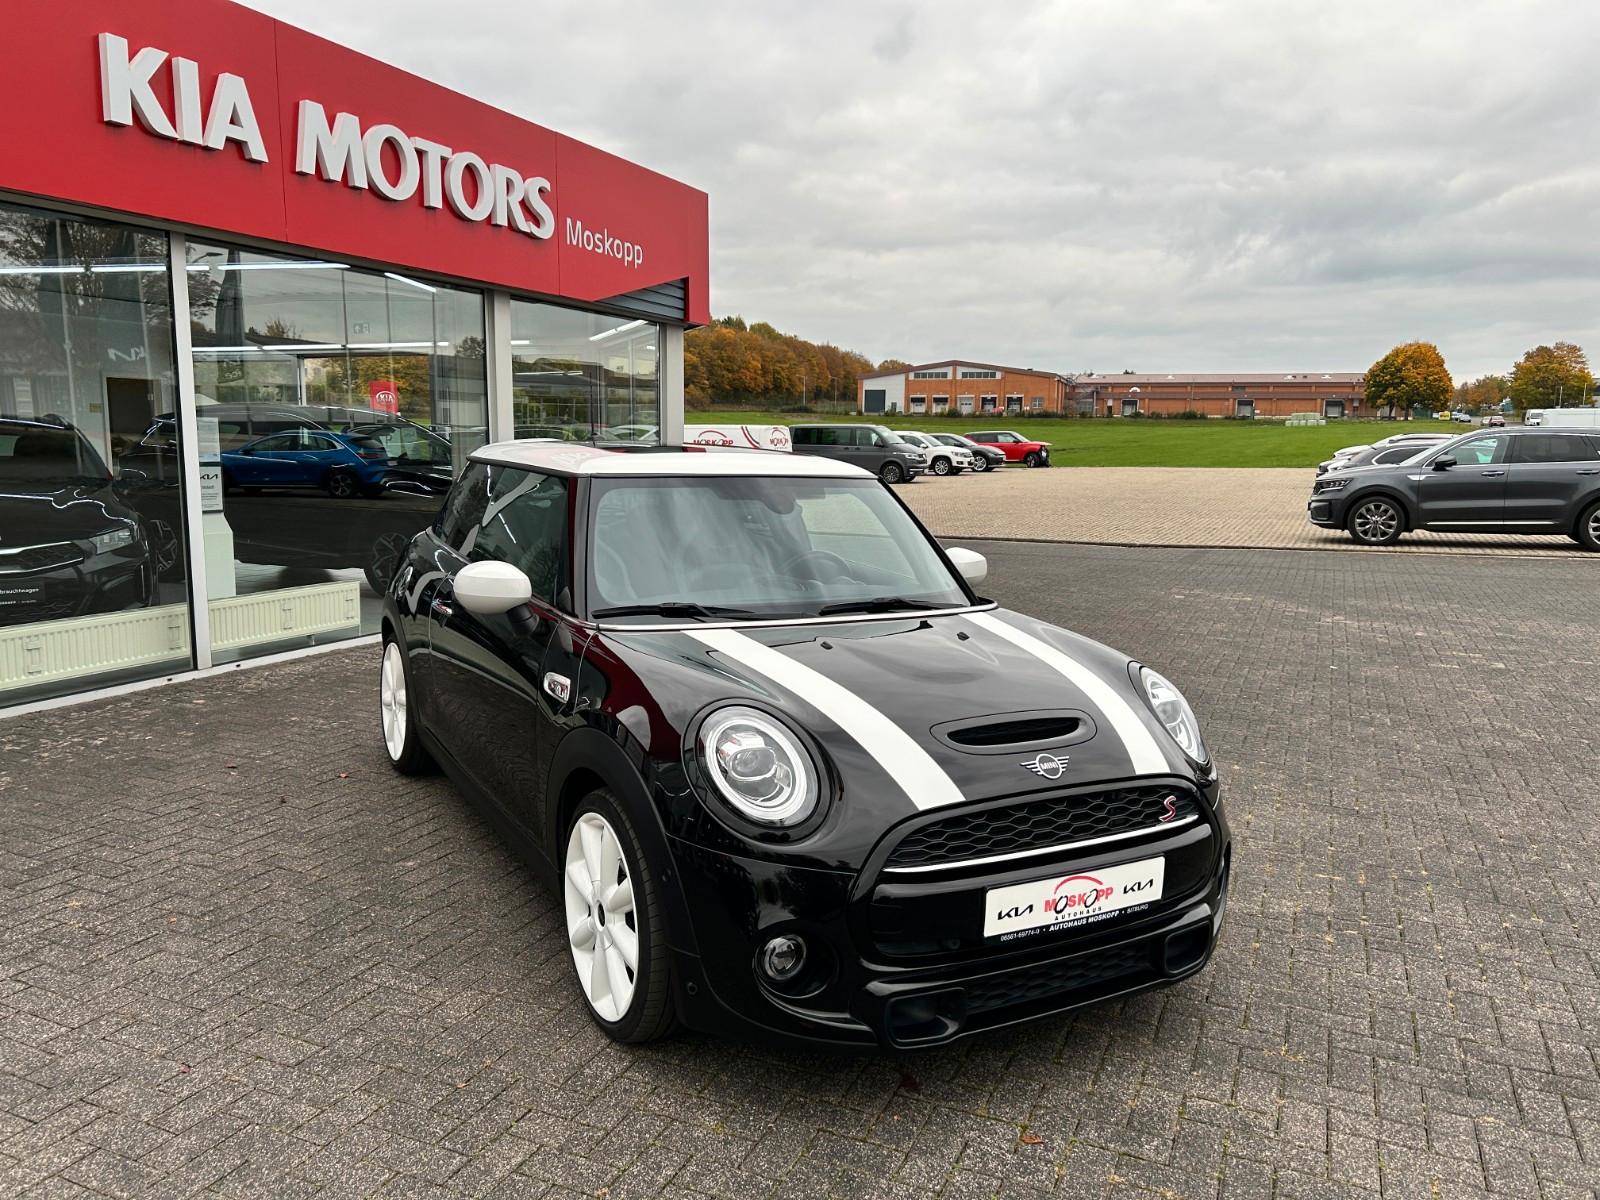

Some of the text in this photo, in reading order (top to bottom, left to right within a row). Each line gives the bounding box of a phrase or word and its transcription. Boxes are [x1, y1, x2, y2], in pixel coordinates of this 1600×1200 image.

[98, 32, 555, 240] KIA MOTORS
[566, 216, 643, 269] Moskopp
[1040, 761, 1058, 770] MINI
[1159, 795, 1177, 822] S
[1123, 878, 1154, 895] KIA
[997, 903, 1034, 920] KIA
[1044, 887, 1114, 914] MOSKOPP
[1049, 918, 1087, 932] AUTOHAUS
[1088, 910, 1120, 924] MOSKOPP
[1054, 906, 1102, 921] AUTOHAUS
